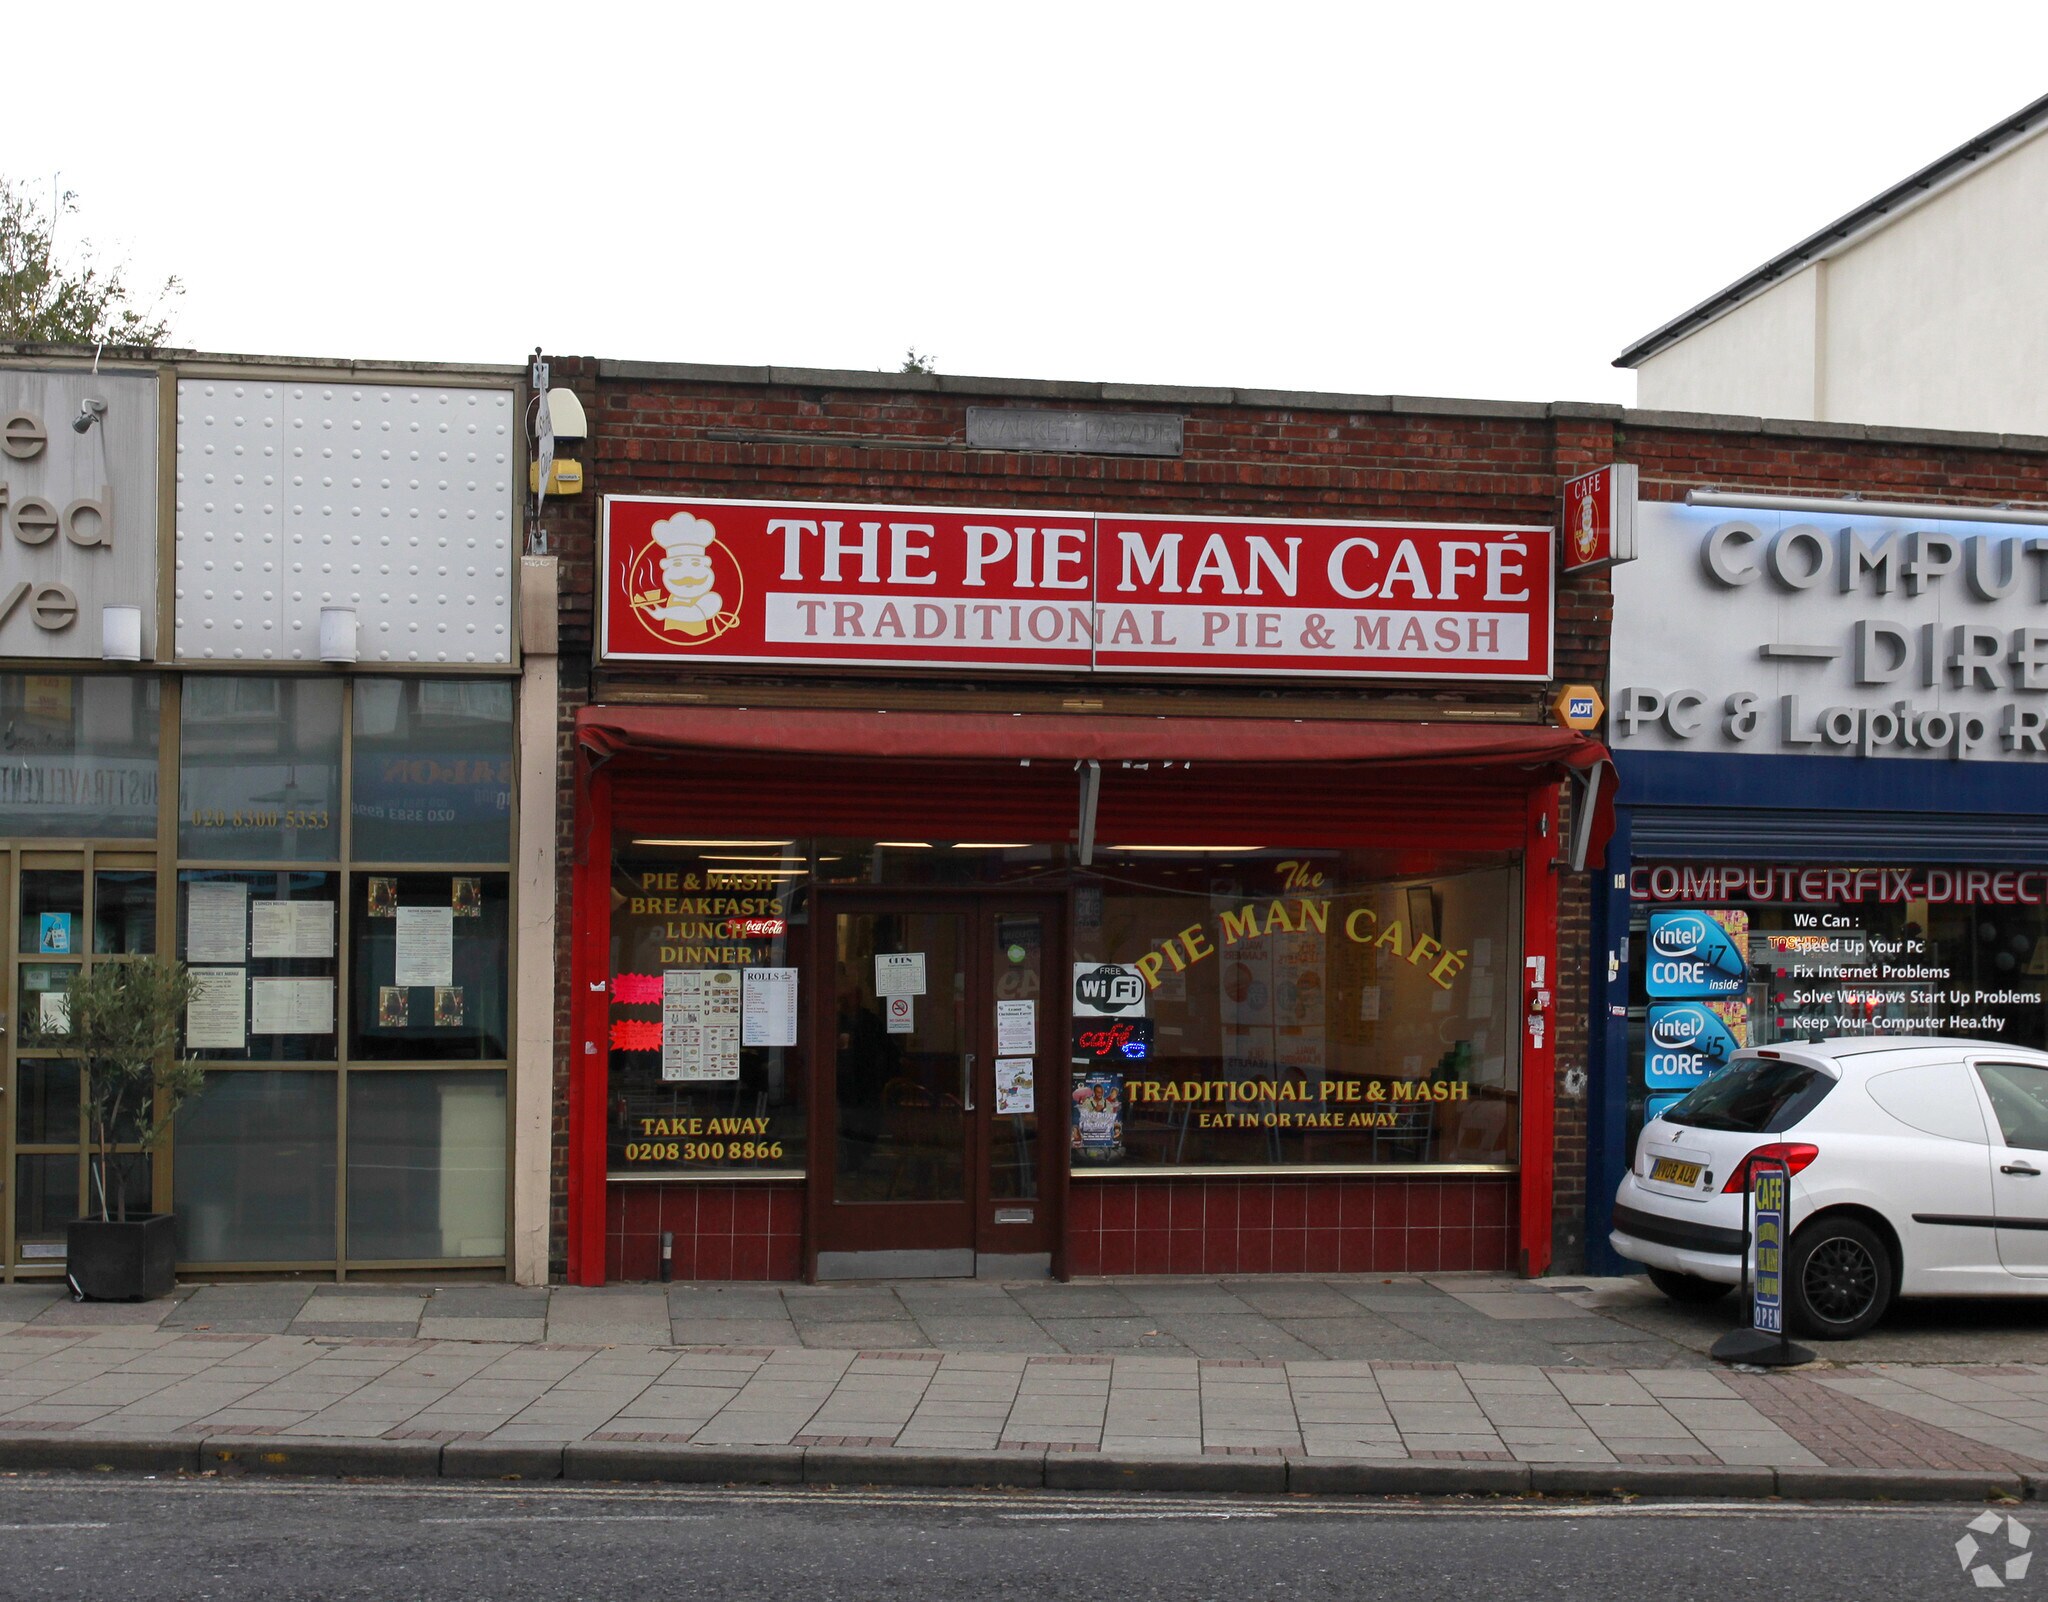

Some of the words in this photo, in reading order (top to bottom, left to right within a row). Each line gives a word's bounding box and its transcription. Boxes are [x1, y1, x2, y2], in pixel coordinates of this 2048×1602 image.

[977, 415, 1072, 442] MARKET
[1085, 421, 1174, 444] PARADE
[1574, 473, 1601, 500] CAFE
[766, 518, 937, 585] THE
[962, 525, 1089, 589] PIE
[1116, 532, 1302, 597] MAN
[1327, 533, 1530, 602] CAFÉ
[797, 600, 1177, 646] TRADITIONAL
[1202, 611, 1283, 649] PIE
[1300, 613, 1336, 650] &
[1354, 615, 1501, 653] MASH
[1570, 702, 1592, 715] ADT
[1618, 687, 1707, 739] PC
[1722, 691, 1767, 741] &
[1782, 695, 1987, 760] Laptop
[1999, 701, 2048, 752] R
[191, 810, 225, 828] 020
[233, 810, 277, 828] 8300
[284, 810, 329, 829] 5353
[642, 873, 678, 891] PIE
[683, 873, 700, 891] &
[706, 873, 773, 891] MASH
[1275, 860, 1325, 890] The
[630, 897, 783, 915] BREAKFASTS
[1794, 914, 1818, 927] We
[1822, 914, 1850, 927] Can
[666, 922, 747, 940] LUNCH
[1659, 927, 1697, 945] intel
[1134, 923, 1214, 991] PIE
[1218, 898, 1331, 946] MAN
[1345, 908, 1470, 991] CAFÉ
[1793, 940, 1839, 956] Speed
[1844, 941, 1864, 956] Up
[1869, 940, 1903, 954] Your
[659, 946, 753, 964] DINNER
[1706, 945, 1727, 966] i7
[747, 972, 779, 981] ROLLS
[1099, 967, 1121, 975] FREE
[1652, 962, 1704, 984] CORE
[1793, 965, 1814, 978] Fix
[1818, 965, 1878, 979] Internet
[1882, 965, 1950, 979] Problems
[1709, 979, 1739, 990] inside
[1793, 990, 1832, 1003] Solve
[1837, 990, 1905, 1004] Windows
[1910, 990, 1945, 1003] Start
[1950, 990, 1970, 1006] Up
[1974, 990, 2041, 1003] Problems
[1658, 1018, 1696, 1037] intel
[1793, 1015, 1831, 1031] Keep
[1835, 1016, 1866, 1029] Your
[1872, 1015, 1946, 1031] Computer
[1950, 1015, 2006, 1031] Heathy
[1079, 1023, 1134, 1055] café
[1705, 1036, 1725, 1056] i5
[1651, 1054, 1704, 1075] CORE
[1124, 1080, 1313, 1102] TRADITIONAL
[1319, 1080, 1362, 1101] PIE
[1367, 1080, 1388, 1101] &
[1392, 1080, 1470, 1101] MASH
[641, 1117, 703, 1136] TAKE
[706, 1117, 770, 1136] AWAY
[1199, 1112, 1236, 1128] EAT
[1238, 1112, 1259, 1128] IN
[1264, 1112, 1291, 1128] OR
[1294, 1112, 1345, 1128] TAKE
[1348, 1112, 1399, 1128] AWAY
[625, 1142, 679, 1161] 0208
[683, 1142, 724, 1160] 300
[729, 1141, 783, 1160] 8866
[1756, 1177, 1782, 1211] CAFE
[1756, 1306, 1780, 1330] OPEN
